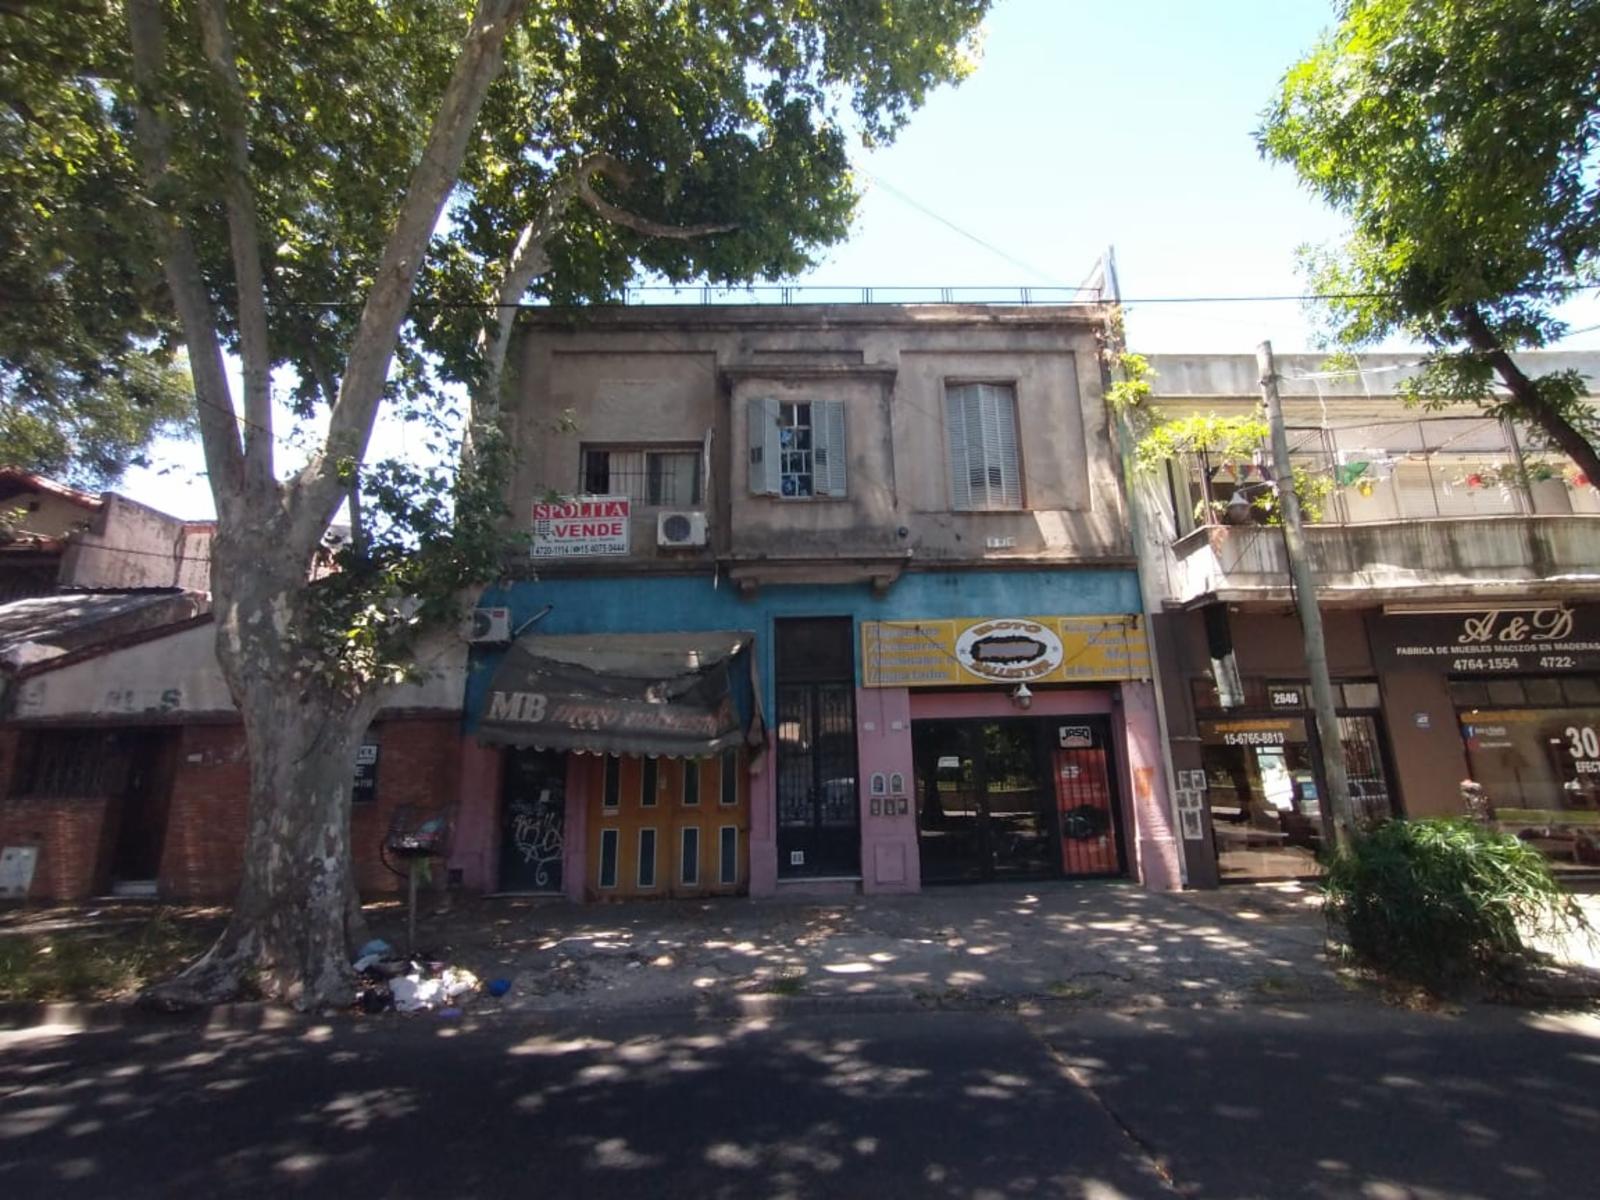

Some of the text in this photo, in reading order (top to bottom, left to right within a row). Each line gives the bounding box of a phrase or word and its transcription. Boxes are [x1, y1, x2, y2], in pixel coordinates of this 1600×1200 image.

[555, 522, 623, 538] VENDE
[1396, 646, 1435, 656] FABRICA
[1435, 645, 1449, 654] DE
[1450, 644, 1493, 654] MUEBLES
[1538, 643, 1552, 652] EN
[1453, 658, 1519, 671] 4764-1554
[485, 691, 549, 723] MB
